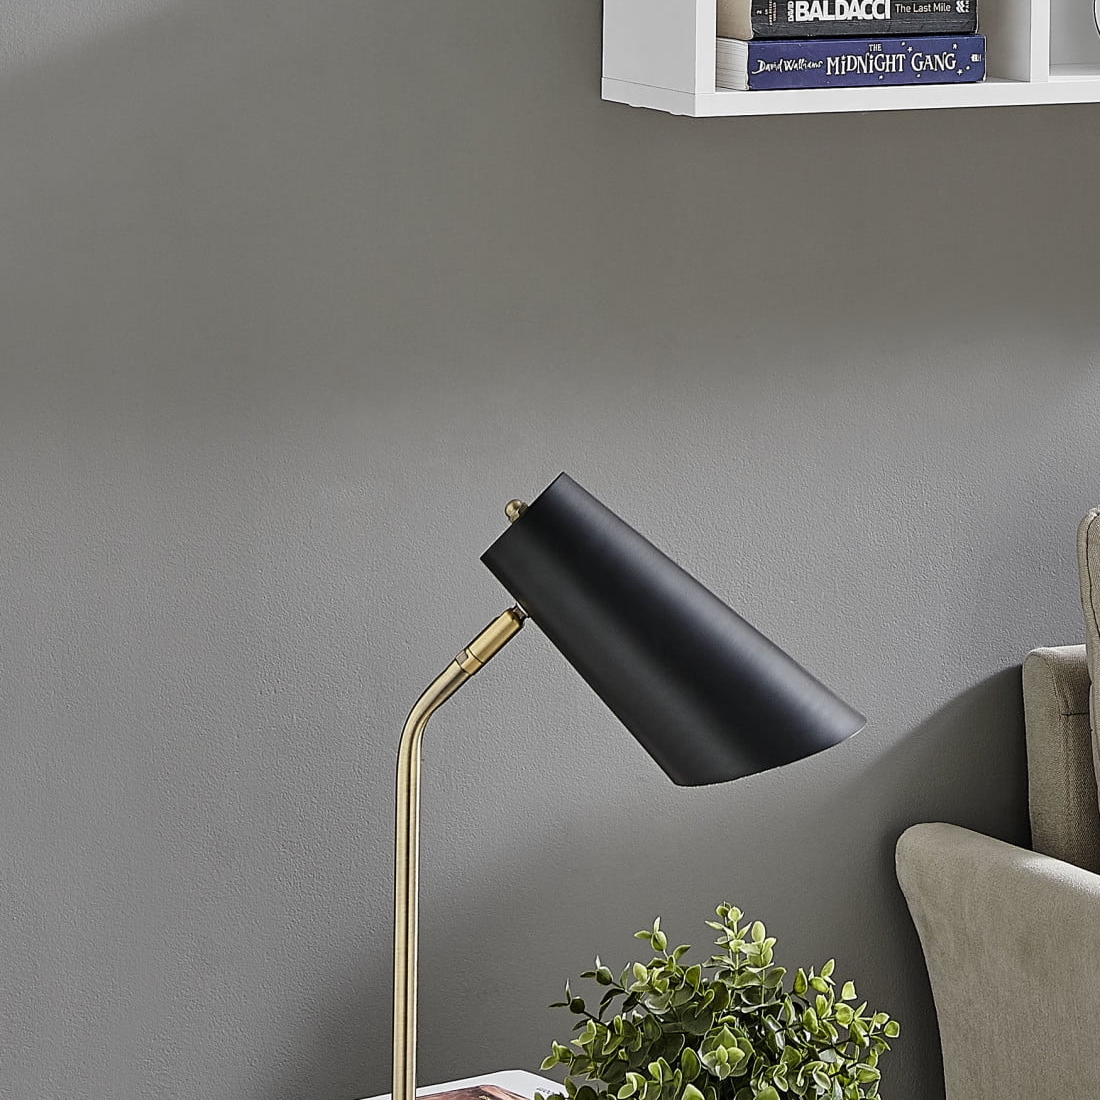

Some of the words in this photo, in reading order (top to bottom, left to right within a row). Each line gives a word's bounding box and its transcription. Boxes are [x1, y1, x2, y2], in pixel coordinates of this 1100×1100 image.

[895, 3, 911, 13] The
[913, 3, 932, 13] Last
[933, 2, 951, 12] Mile
[868, 43, 882, 52] THE
[751, 58, 783, 74] David
[783, 58, 823, 71] Walliams
[911, 51, 957, 72] GANG
